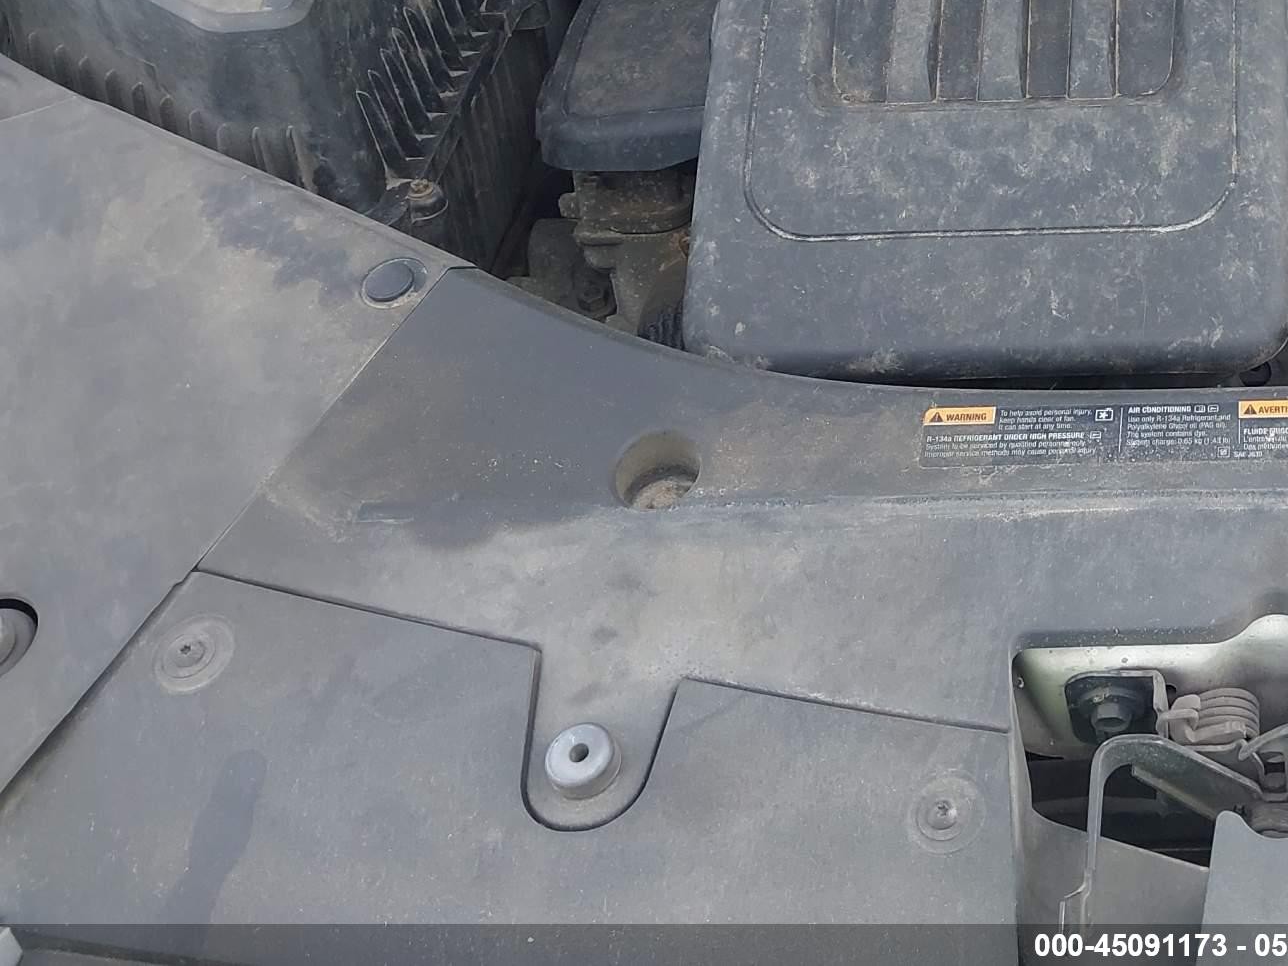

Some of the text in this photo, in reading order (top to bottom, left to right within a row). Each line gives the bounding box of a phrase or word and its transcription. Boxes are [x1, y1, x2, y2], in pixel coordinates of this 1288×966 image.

[946, 412, 986, 422] WARNING
[1010, 410, 1023, 418] help
[1044, 410, 1071, 418] personal
